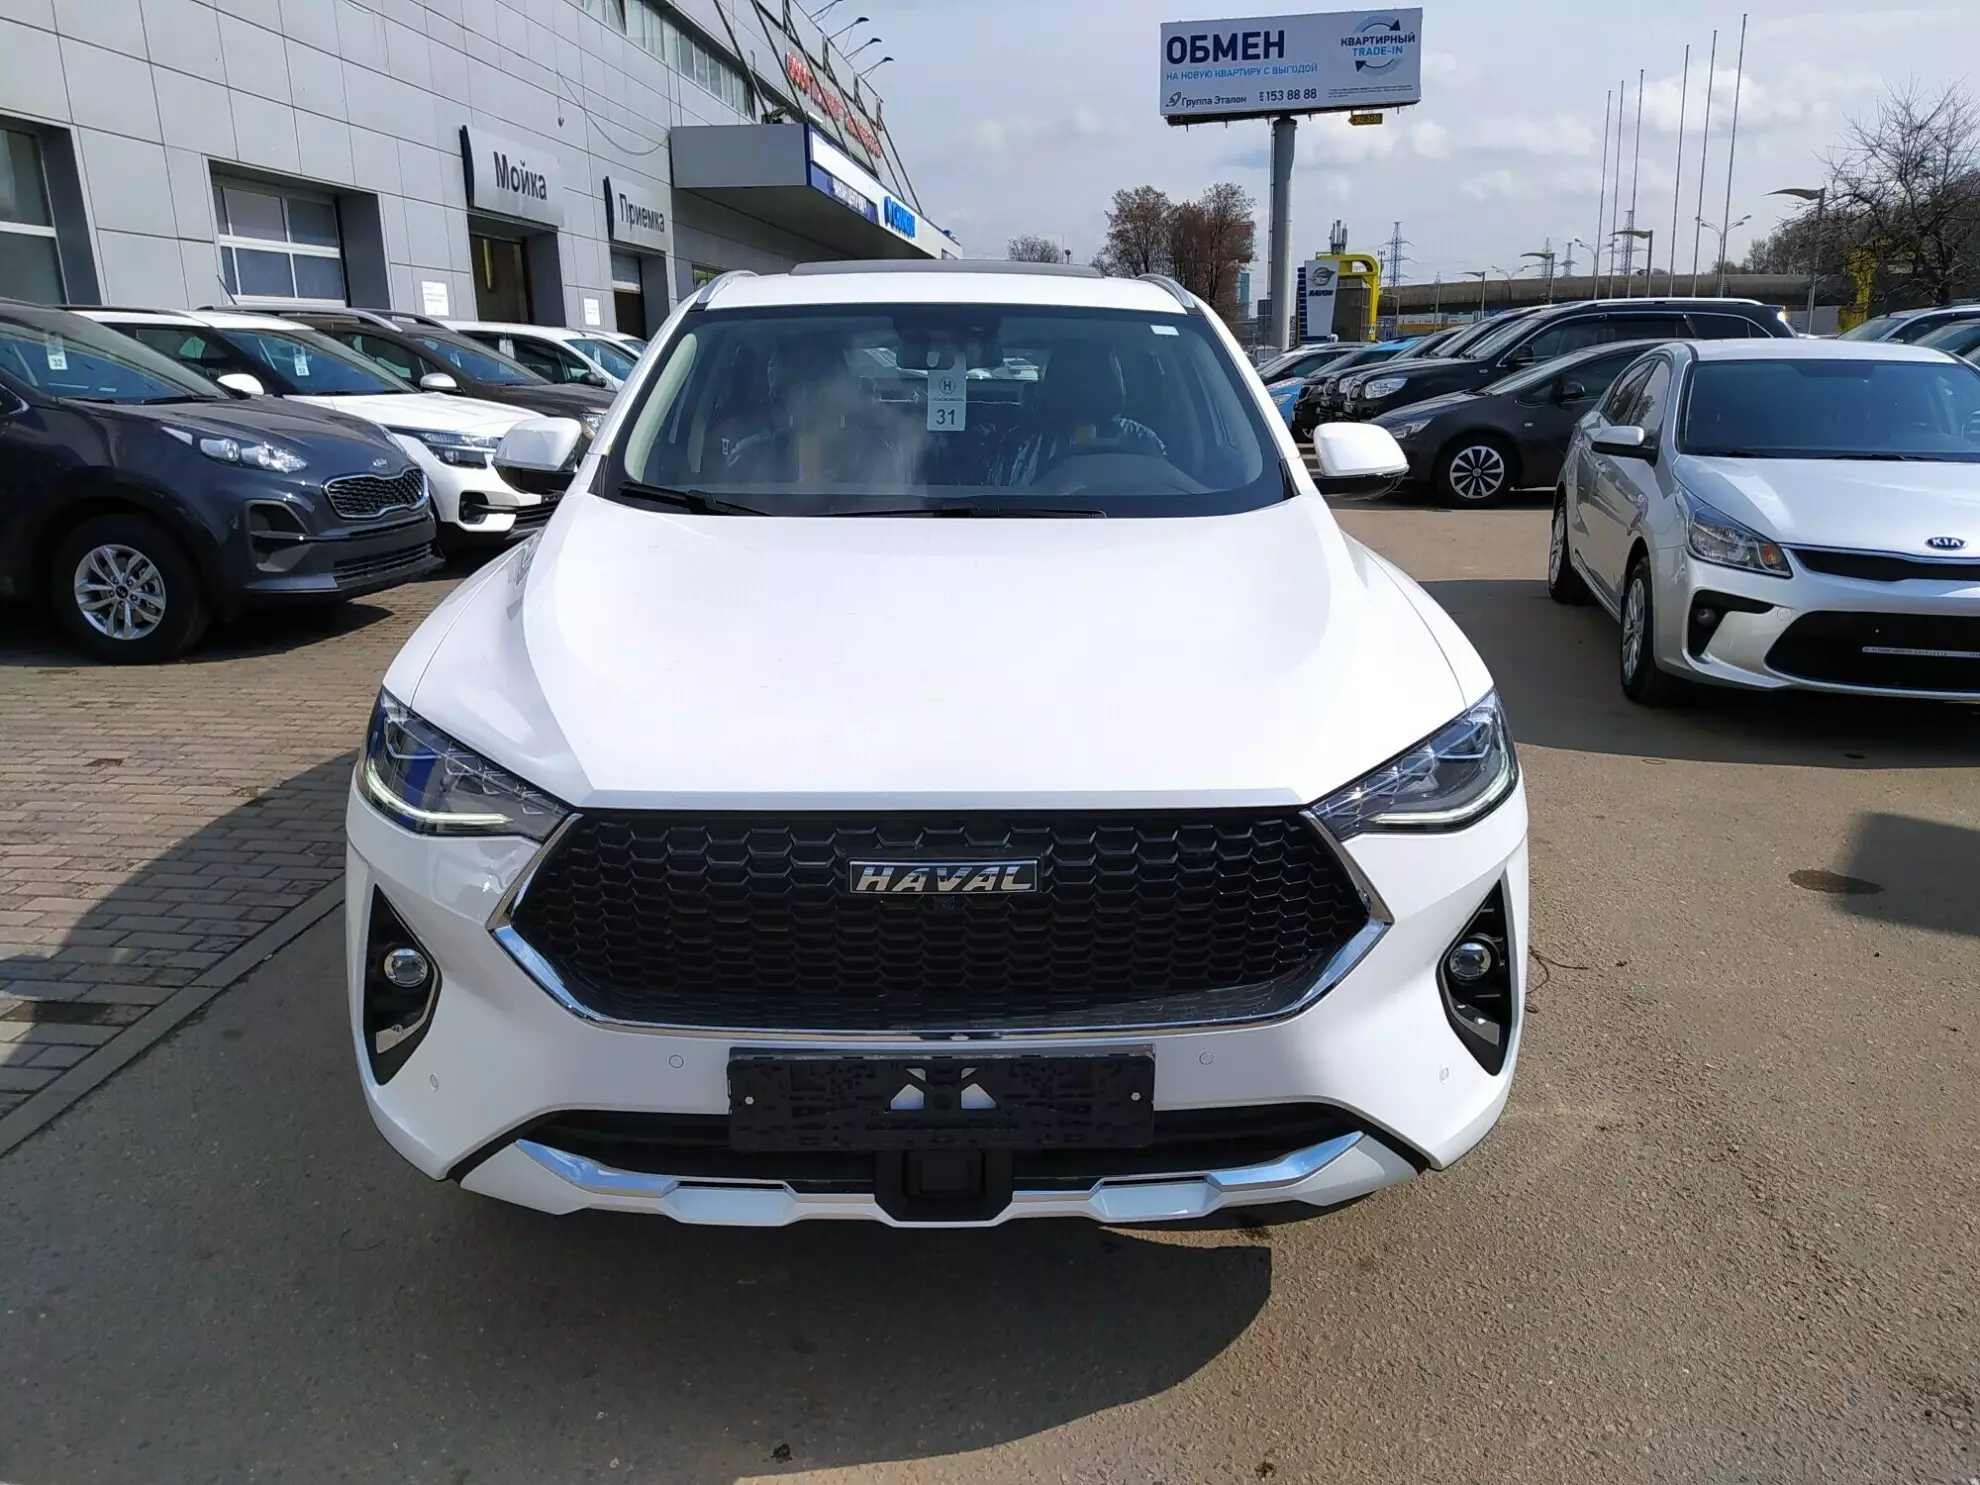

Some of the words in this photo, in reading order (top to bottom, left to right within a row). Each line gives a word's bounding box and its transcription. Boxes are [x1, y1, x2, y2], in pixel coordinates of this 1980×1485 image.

[1166, 30, 1284, 64] ОБМЕН
[1341, 32, 1416, 46] КВАРТИРНЫЙ
[1352, 45, 1404, 57] TRADE-IN
[1166, 72, 1180, 81] НА
[1180, 69, 1213, 80] НОВУЮ
[1214, 67, 1261, 78] КВАРТИРУ
[1264, 66, 1271, 75] С
[1272, 63, 1318, 75] ВЫГОДОЙ
[1181, 97, 1213, 108] Группа
[1213, 95, 1247, 105] Эталон
[1266, 91, 1284, 101] 153
[1287, 89, 1301, 100] 88
[1303, 88, 1317, 99] 88
[493, 151, 548, 201] Мойка
[618, 192, 666, 233] Приемка
[935, 408, 956, 426] 31
[1931, 537, 1962, 548] KIA
[856, 866, 1032, 892] HAVAL
